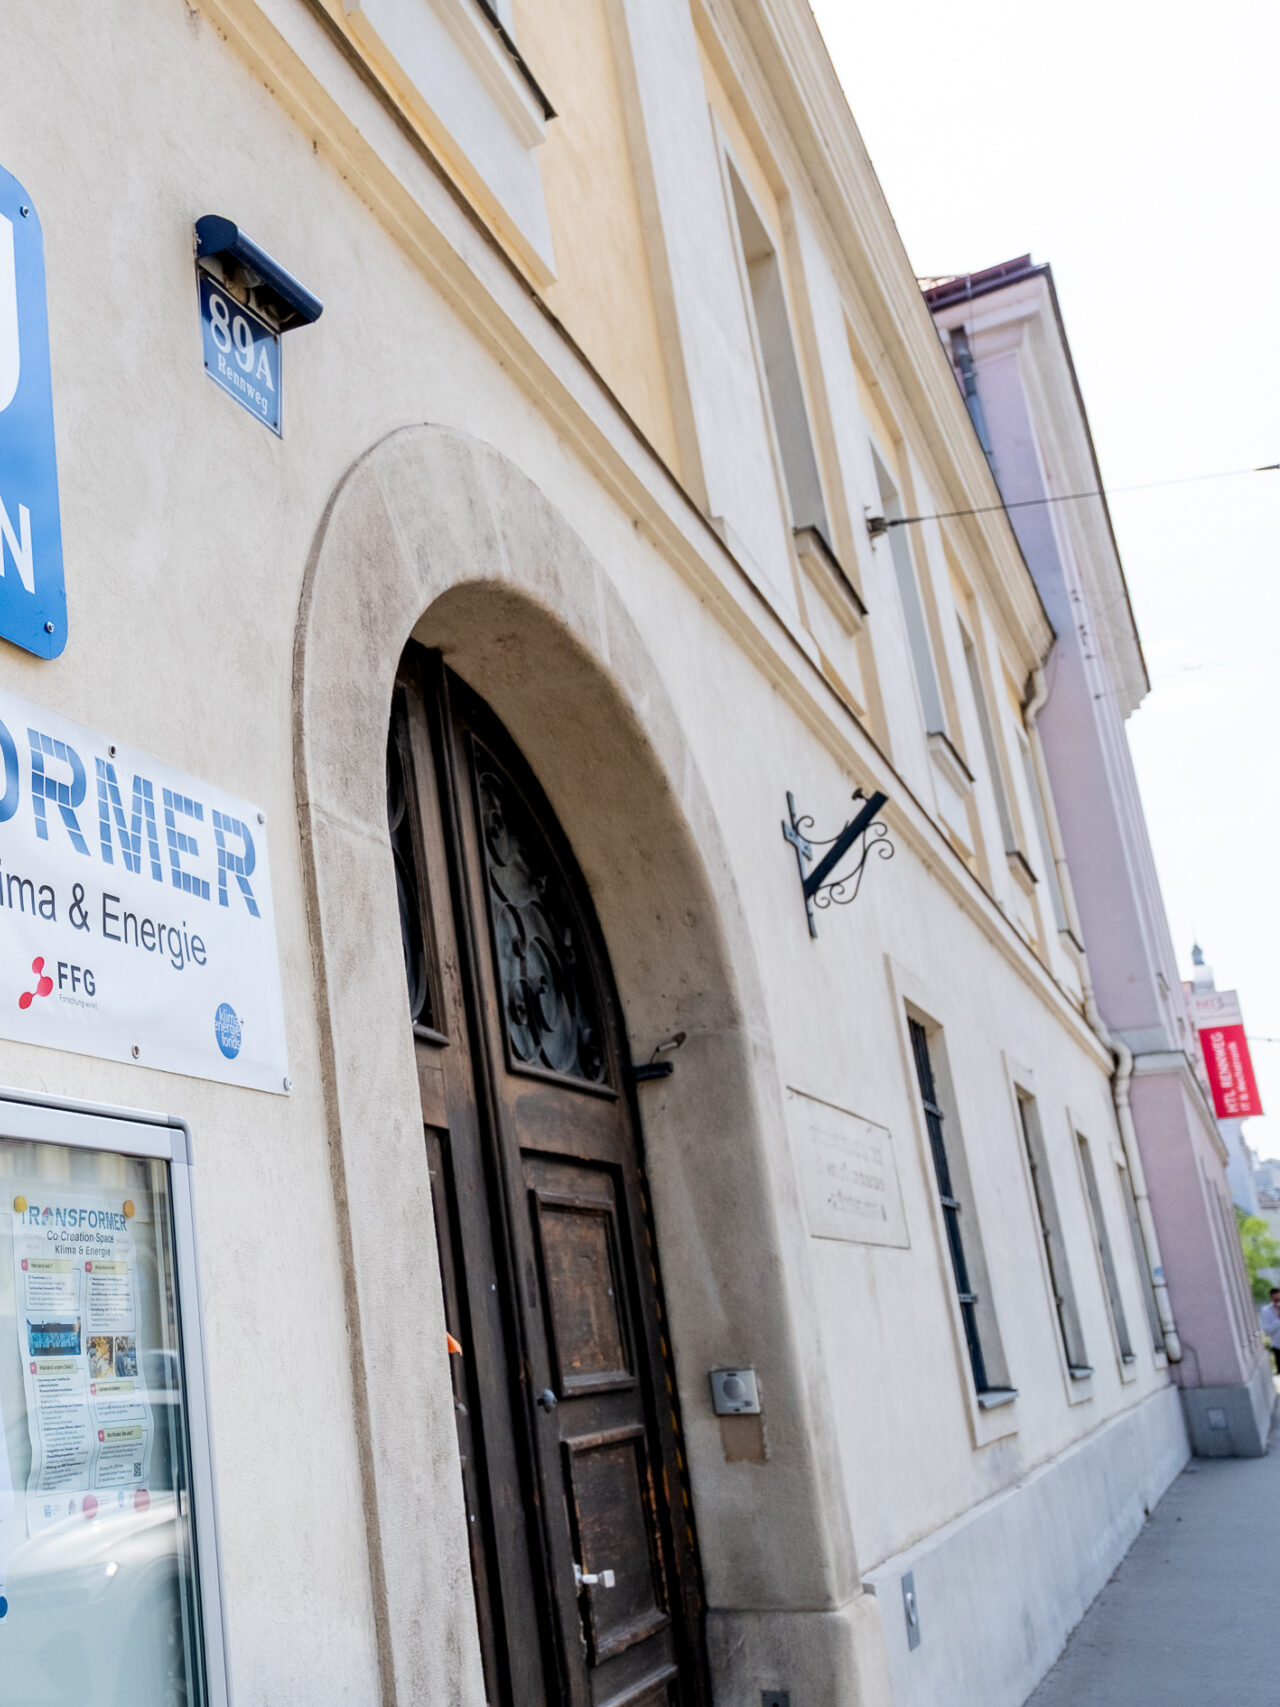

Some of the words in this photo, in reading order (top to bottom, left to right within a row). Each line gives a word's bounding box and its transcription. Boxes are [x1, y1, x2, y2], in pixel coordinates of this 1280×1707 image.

[209, 294, 275, 393] 89A
[217, 353, 268, 415] Rennweg
[69, 883, 91, 931] &
[103, 893, 208, 970] Energie
[57, 961, 96, 997] FFG
[55, 1245, 77, 1255] Klima
[78, 1246, 84, 1255] &
[86, 1247, 111, 1257] Energie
